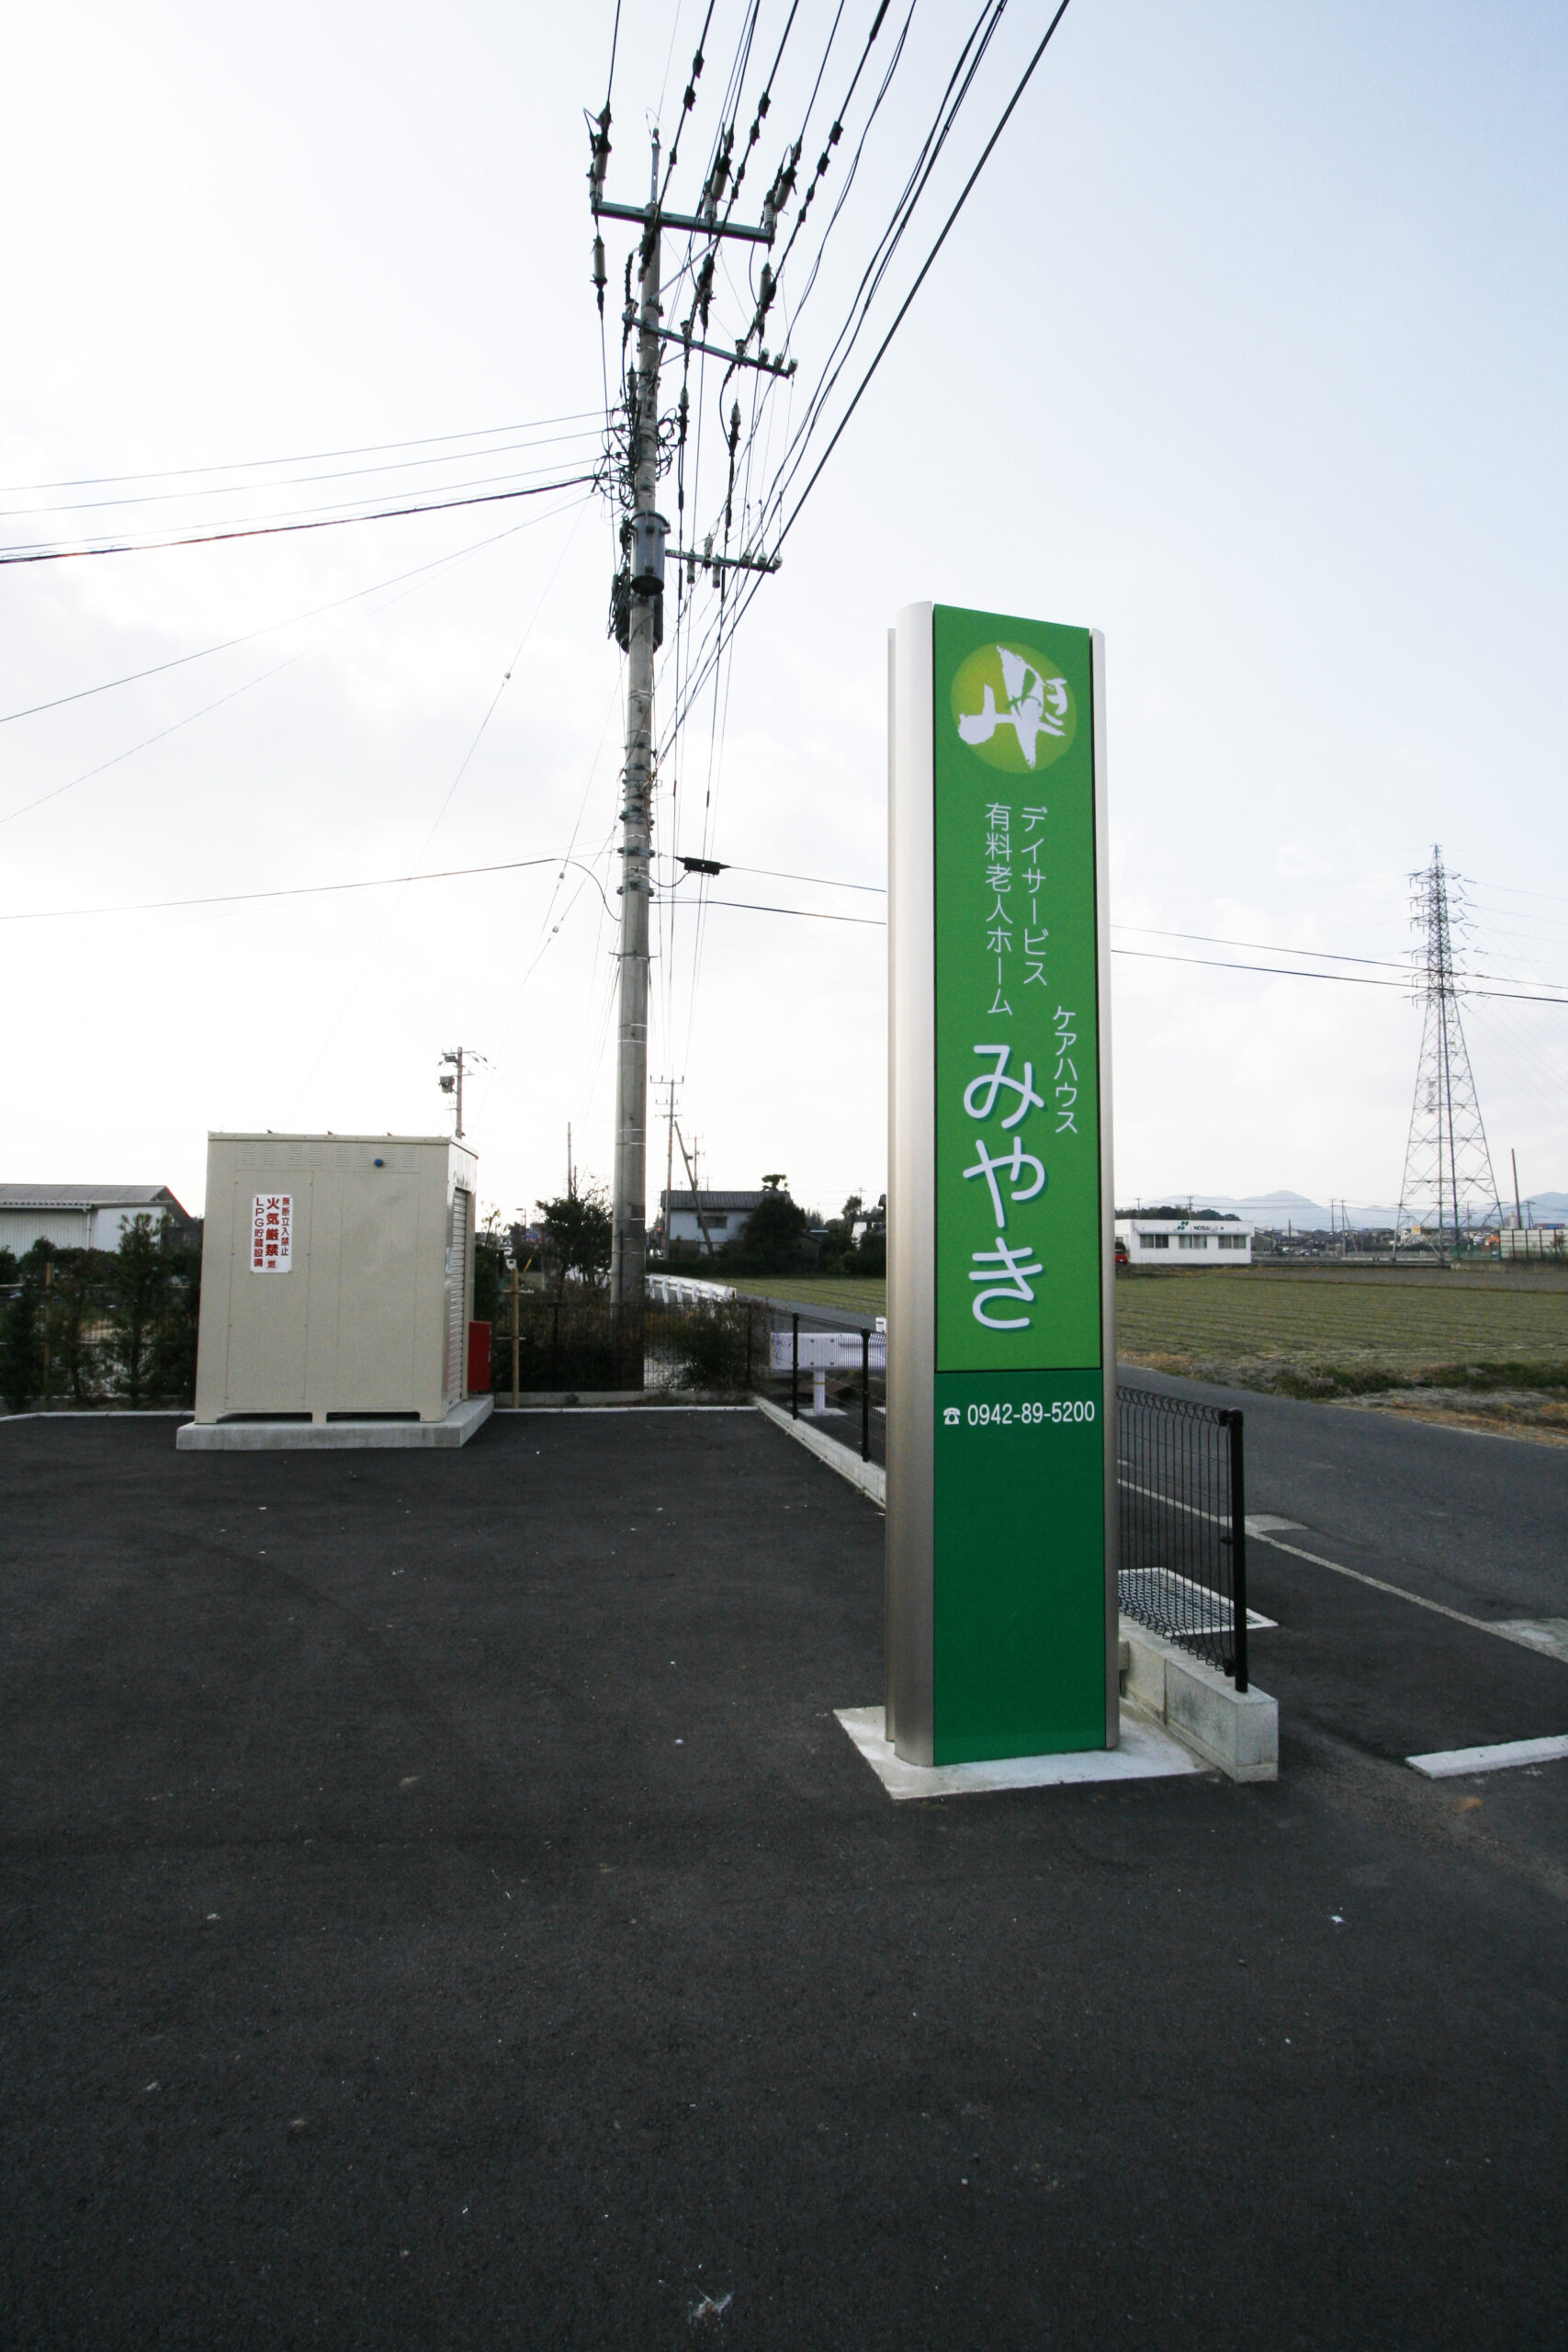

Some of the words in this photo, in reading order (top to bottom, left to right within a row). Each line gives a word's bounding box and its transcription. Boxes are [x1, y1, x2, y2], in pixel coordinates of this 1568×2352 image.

[985, 802, 1012, 1015] 有料老人ホーム
[1021, 806, 1047, 986] デイサービス
[1053, 1006, 1077, 1134] ケアハウス
[254, 1197, 265, 1267] LPG貯蔵設備
[265, 1197, 279, 1256] 火気厳禁
[281, 1197, 290, 1256] 無断立入禁止
[963, 1045, 1045, 1329] みやき
[967, 1401, 1095, 1425] 0942-89-5200
